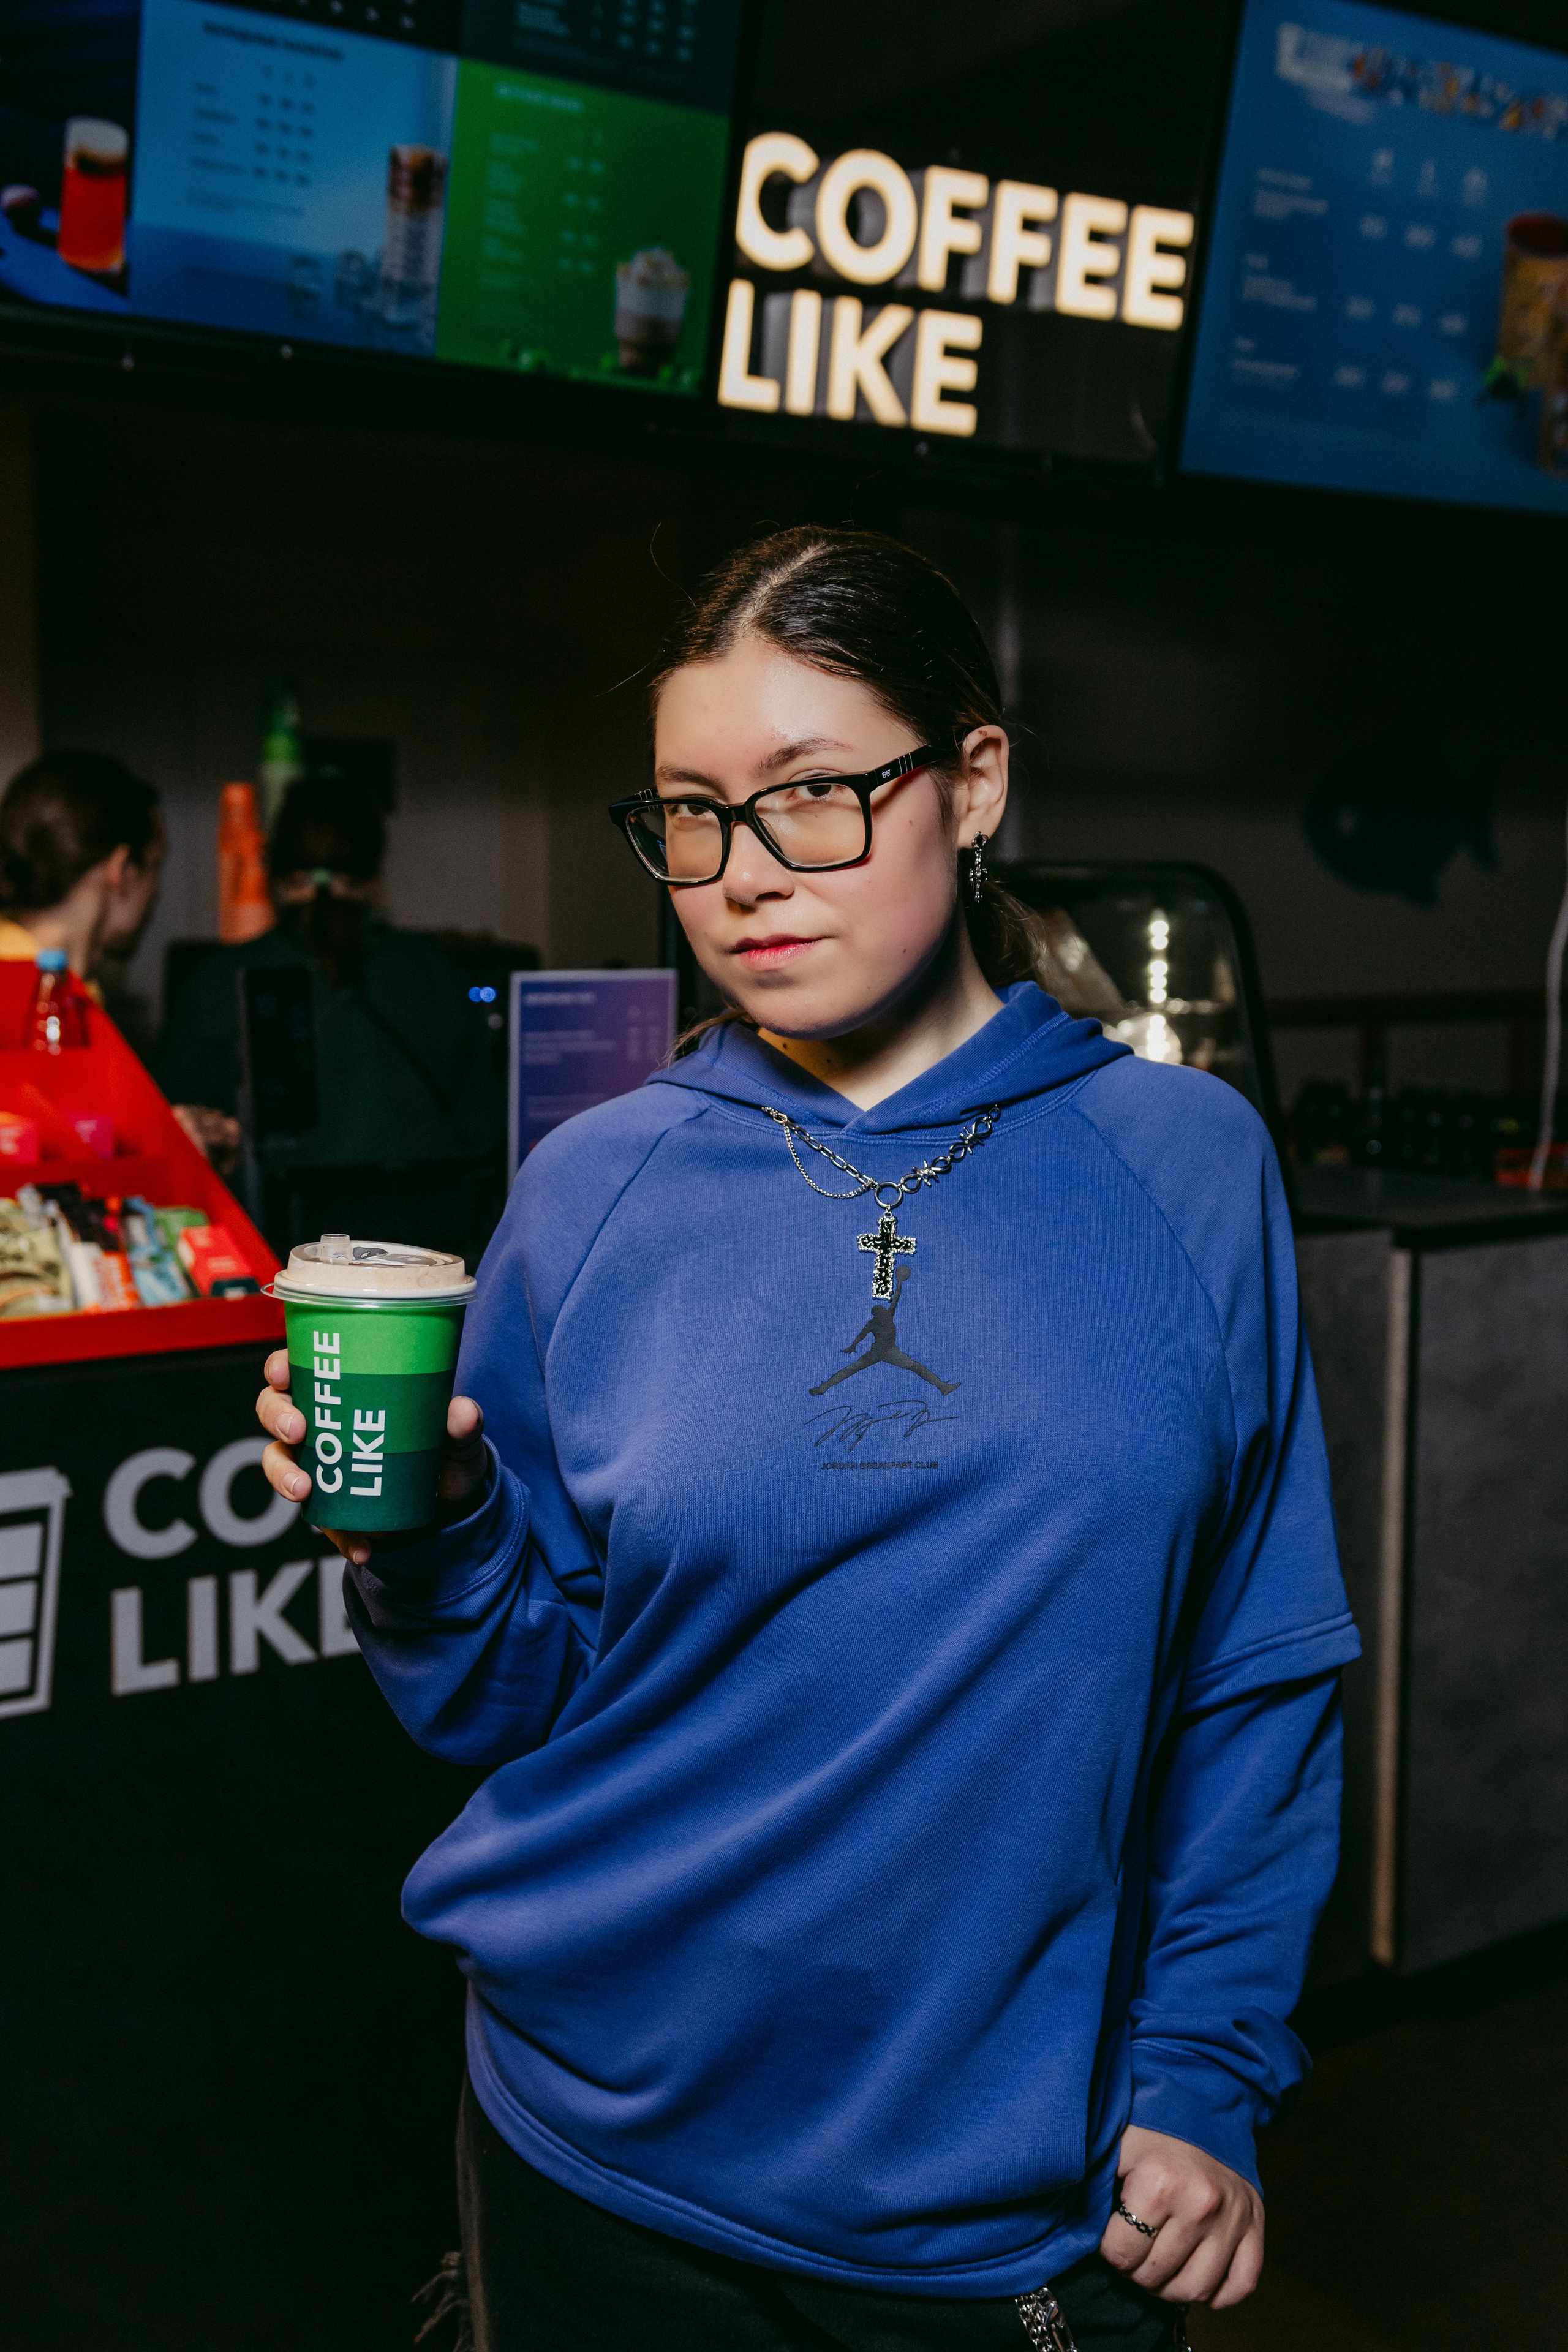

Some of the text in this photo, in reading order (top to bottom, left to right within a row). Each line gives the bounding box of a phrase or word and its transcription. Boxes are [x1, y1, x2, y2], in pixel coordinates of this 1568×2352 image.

[736, 131, 1194, 331] COFFEE
[717, 278, 983, 438] LIKE
[313, 1330, 343, 1493] COFFEE
[350, 1409, 386, 1496] LIKE
[821, 1461, 938, 1471] JORDAN BREAKFAST CLUB
[103, 1436, 322, 1560] CO
